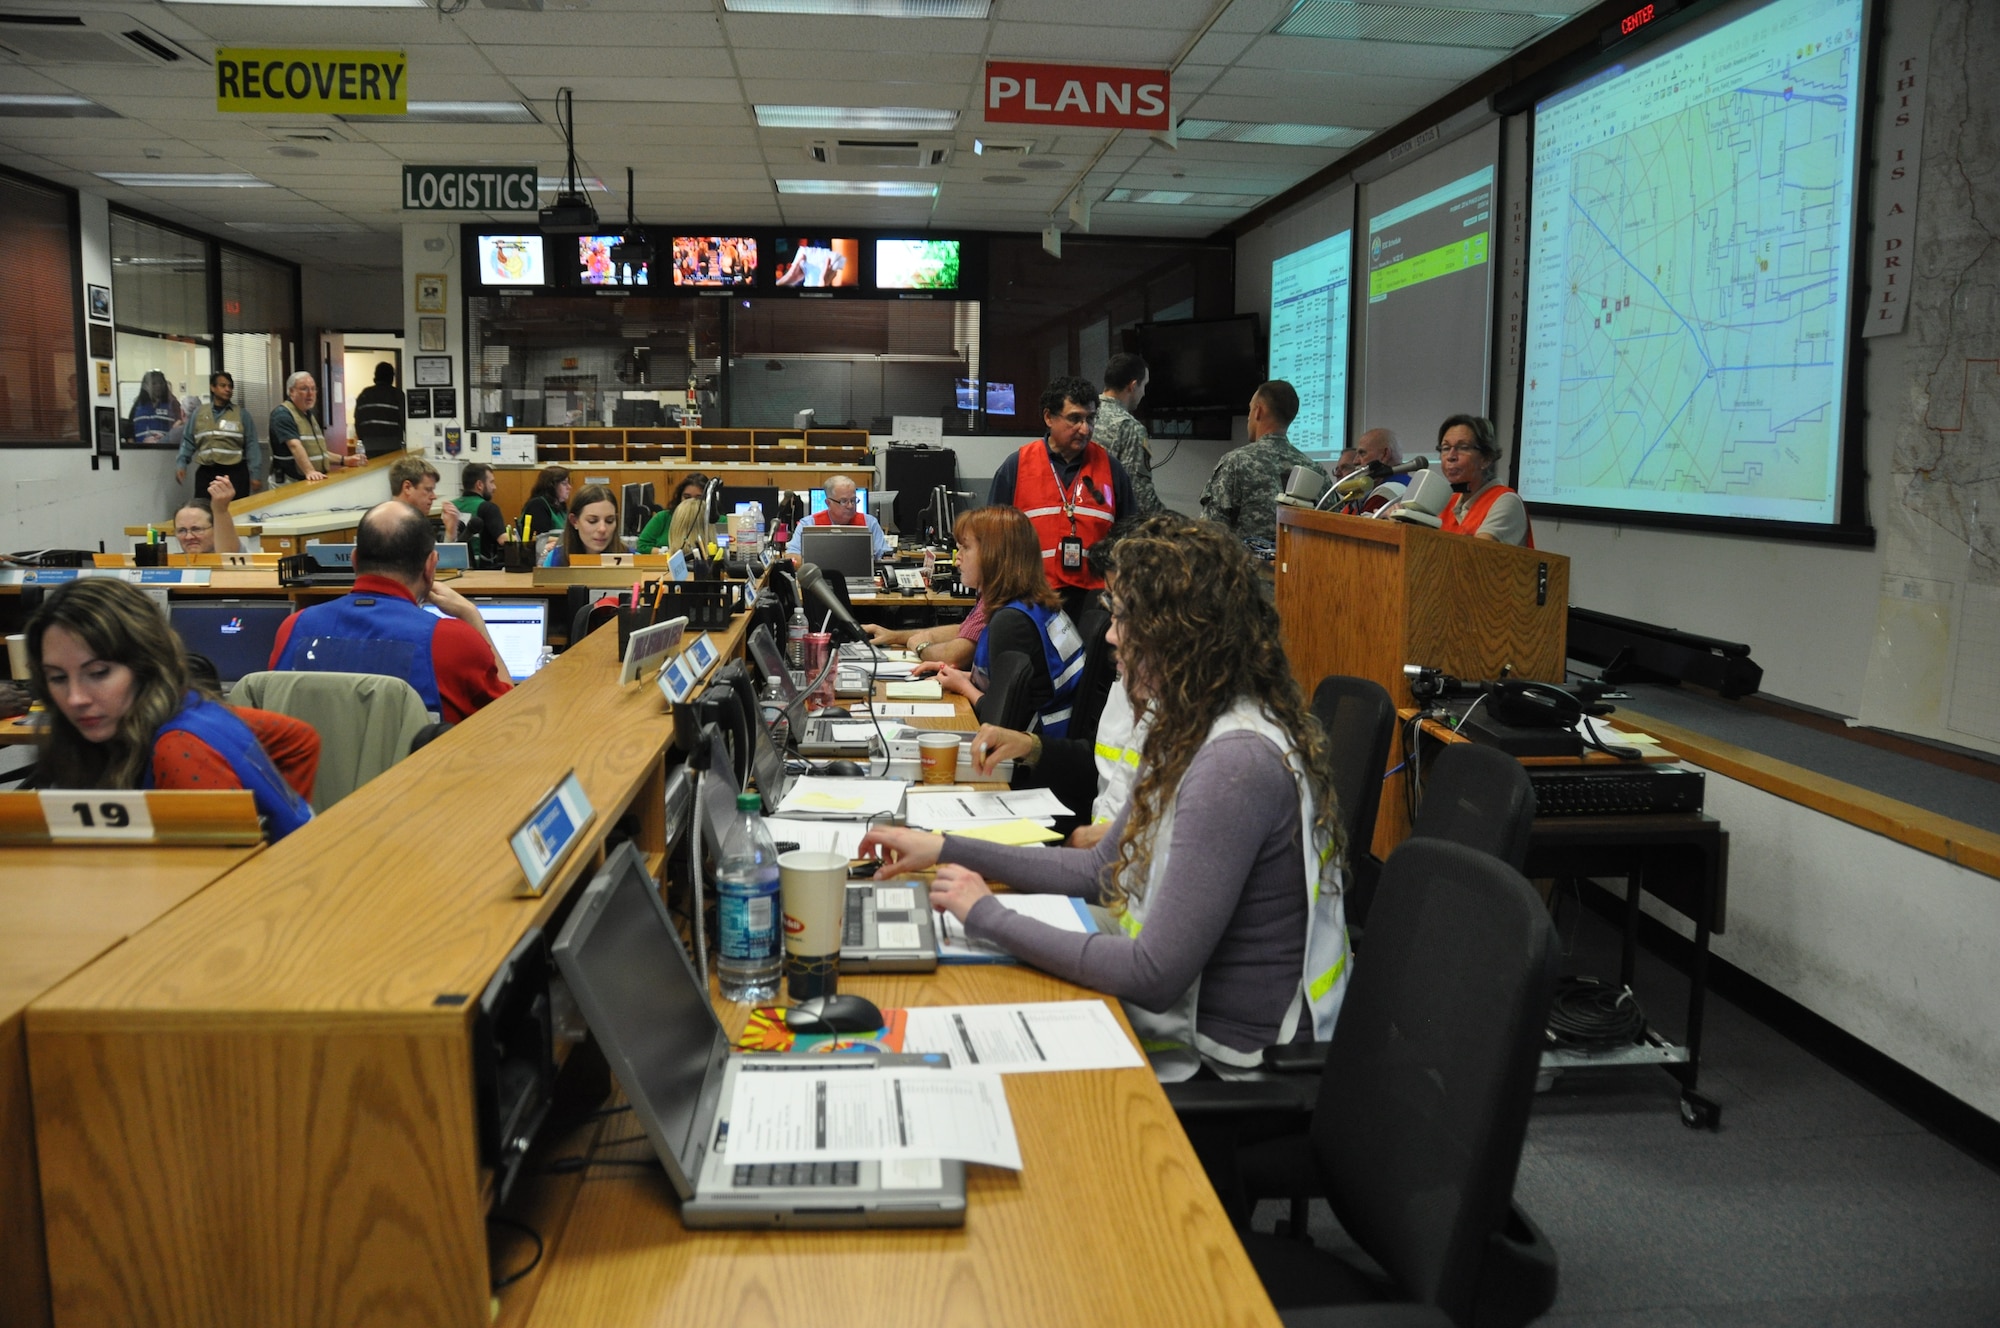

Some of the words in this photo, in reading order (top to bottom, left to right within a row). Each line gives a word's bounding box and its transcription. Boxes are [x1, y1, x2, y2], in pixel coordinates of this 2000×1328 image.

[218, 60, 405, 102] RECOVERY
[988, 77, 1166, 118] PLANS
[1896, 57, 1917, 127] THIS
[1890, 149, 1906, 181] IS
[405, 172, 535, 210] LOGISTICS
[1887, 201, 1905, 216] A
[1513, 201, 1522, 244] THIS
[1512, 257, 1519, 278] IS
[1878, 238, 1903, 321] DRILL
[1509, 313, 1519, 367] DRILL
[228, 556, 246, 567] 11
[613, 556, 622, 566] 7
[71, 801, 131, 828] 19
